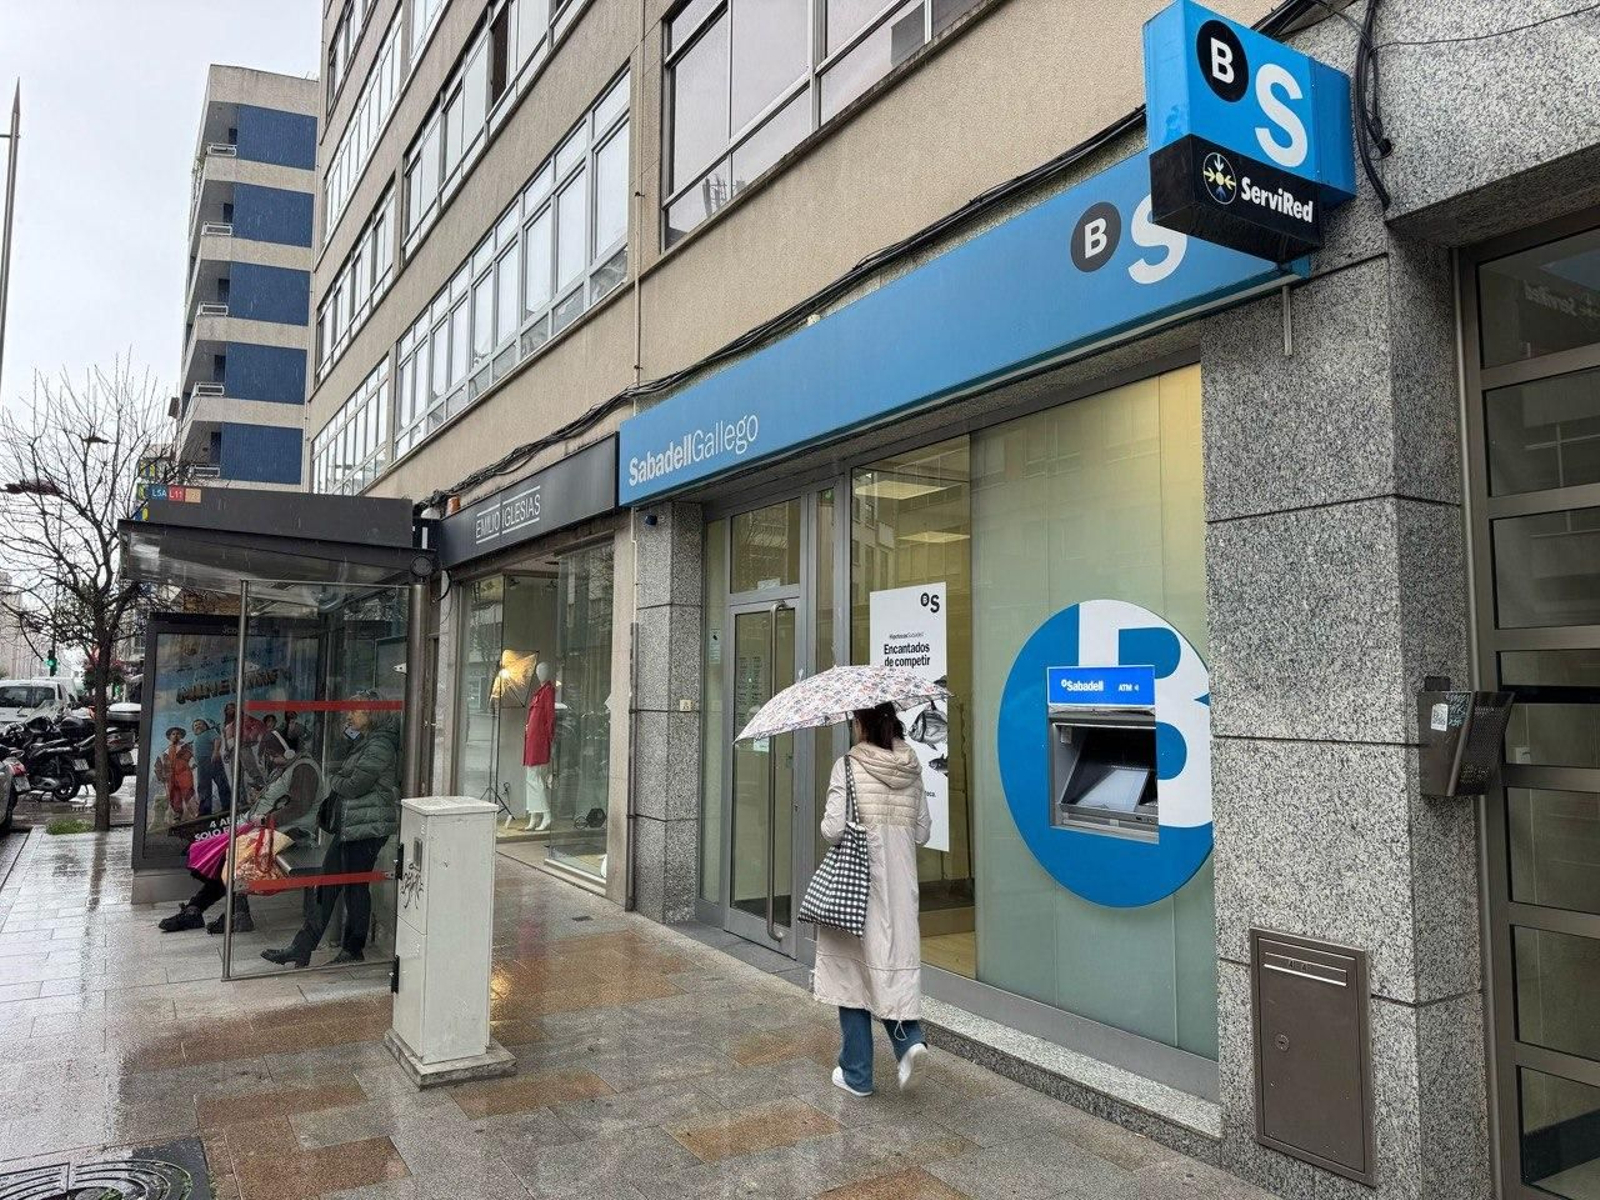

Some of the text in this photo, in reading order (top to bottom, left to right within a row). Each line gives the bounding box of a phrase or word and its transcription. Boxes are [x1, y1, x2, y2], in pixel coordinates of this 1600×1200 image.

[1211, 37, 1308, 168] B S
[1241, 176, 1313, 223] ServiRed
[1084, 194, 1187, 284] B S
[629, 414, 759, 487] SabadellGallego
[476, 494, 541, 539] EMILIO IGLESIAS
[884, 642, 930, 655] Encantados
[885, 655, 930, 668] de competir
[1067, 680, 1104, 691] Sabadell
[194, 828, 221, 842] SOLO
[209, 820, 217, 828] 4
